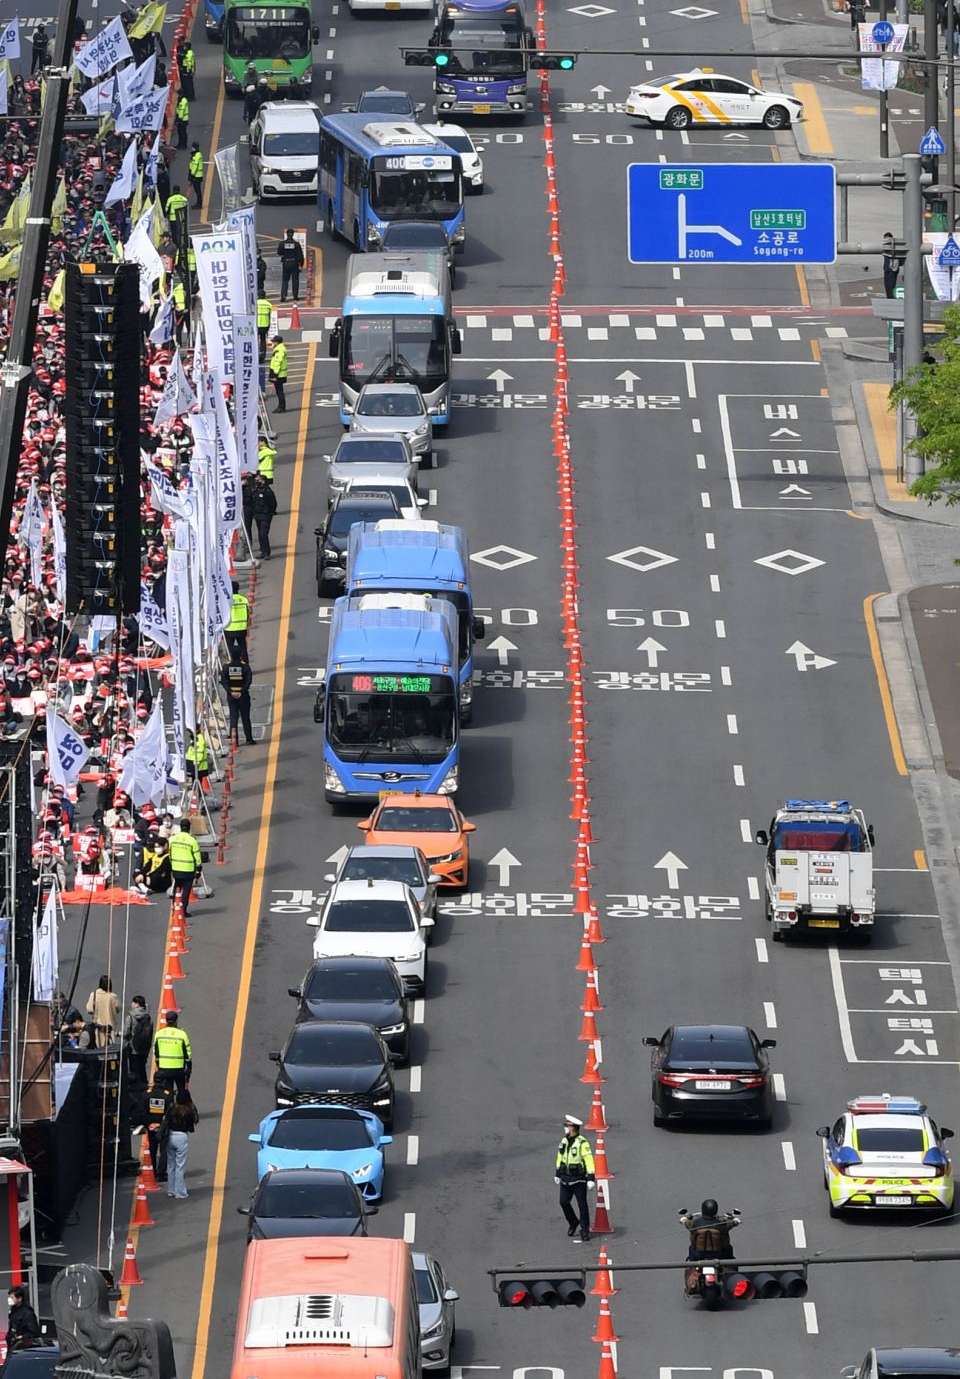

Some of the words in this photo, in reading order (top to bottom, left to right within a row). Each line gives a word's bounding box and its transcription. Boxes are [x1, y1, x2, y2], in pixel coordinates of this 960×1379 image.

[249, 9, 286, 19] 1711
[573, 133, 634, 145] 50
[386, 157, 405, 169] 400
[663, 172, 701, 186] 광화문
[754, 213, 803, 226] 남산3호터널
[757, 231, 800, 244] 소공로
[688, 248, 714, 258] 200m
[754, 245, 803, 256] Sogong-ro
[577, 394, 681, 410] 광화문
[606, 609, 690, 627] 50
[352, 676, 373, 692] 406
[592, 671, 712, 693] 광화문
[440, 892, 574, 917] 광화문
[606, 893, 743, 920] 광화문
